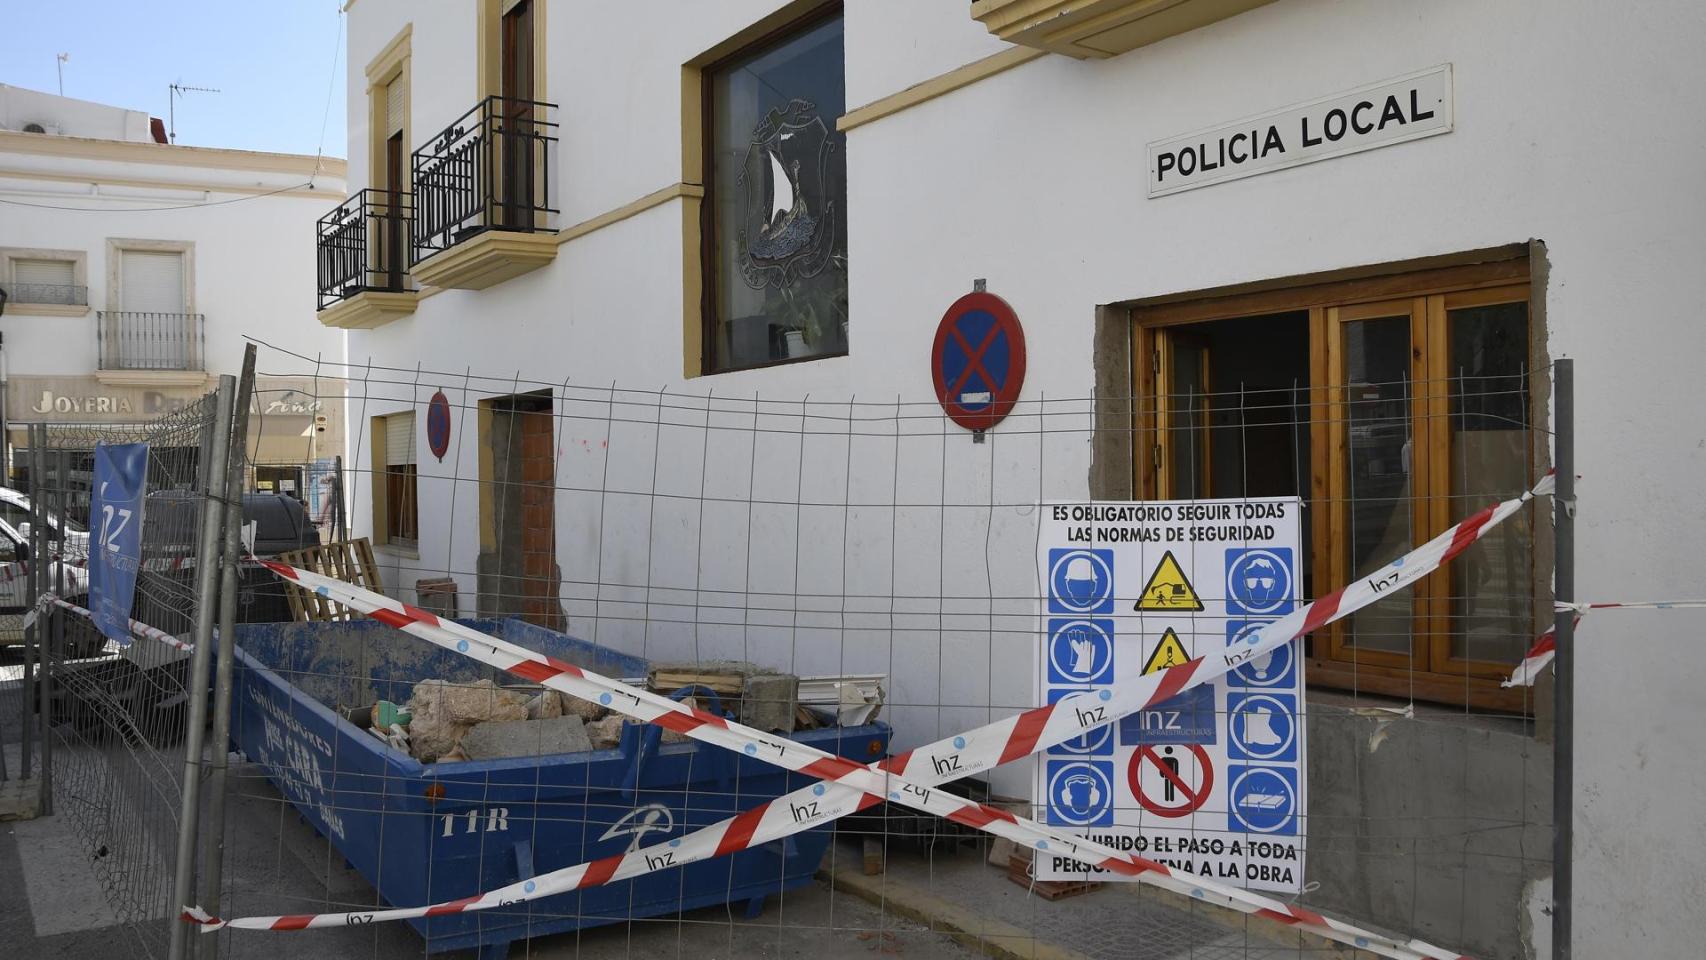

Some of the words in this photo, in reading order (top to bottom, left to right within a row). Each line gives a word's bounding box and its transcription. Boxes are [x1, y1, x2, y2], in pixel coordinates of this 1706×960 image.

[1158, 125, 1286, 182] POLICIA
[1301, 89, 1435, 148] LOCAL
[32, 391, 132, 413] JOYERIA
[1053, 506, 1068, 521] ES
[1072, 506, 1173, 522] OBLIGATORIO
[1177, 504, 1231, 521] SEGUIR
[1235, 503, 1285, 520] TODAS
[1067, 527, 1092, 542] LAS
[1097, 526, 1161, 543] NORMAS
[1166, 526, 1184, 541] DE
[1189, 525, 1275, 542] SEGURIDAD
[1154, 835, 1173, 852] EL
[1178, 837, 1225, 855] PASO
[1229, 840, 1243, 856] A
[1247, 841, 1297, 861] TODA
[1200, 861, 1213, 877] A
[1218, 862, 1240, 879] LA
[1246, 864, 1294, 884] OBRA
